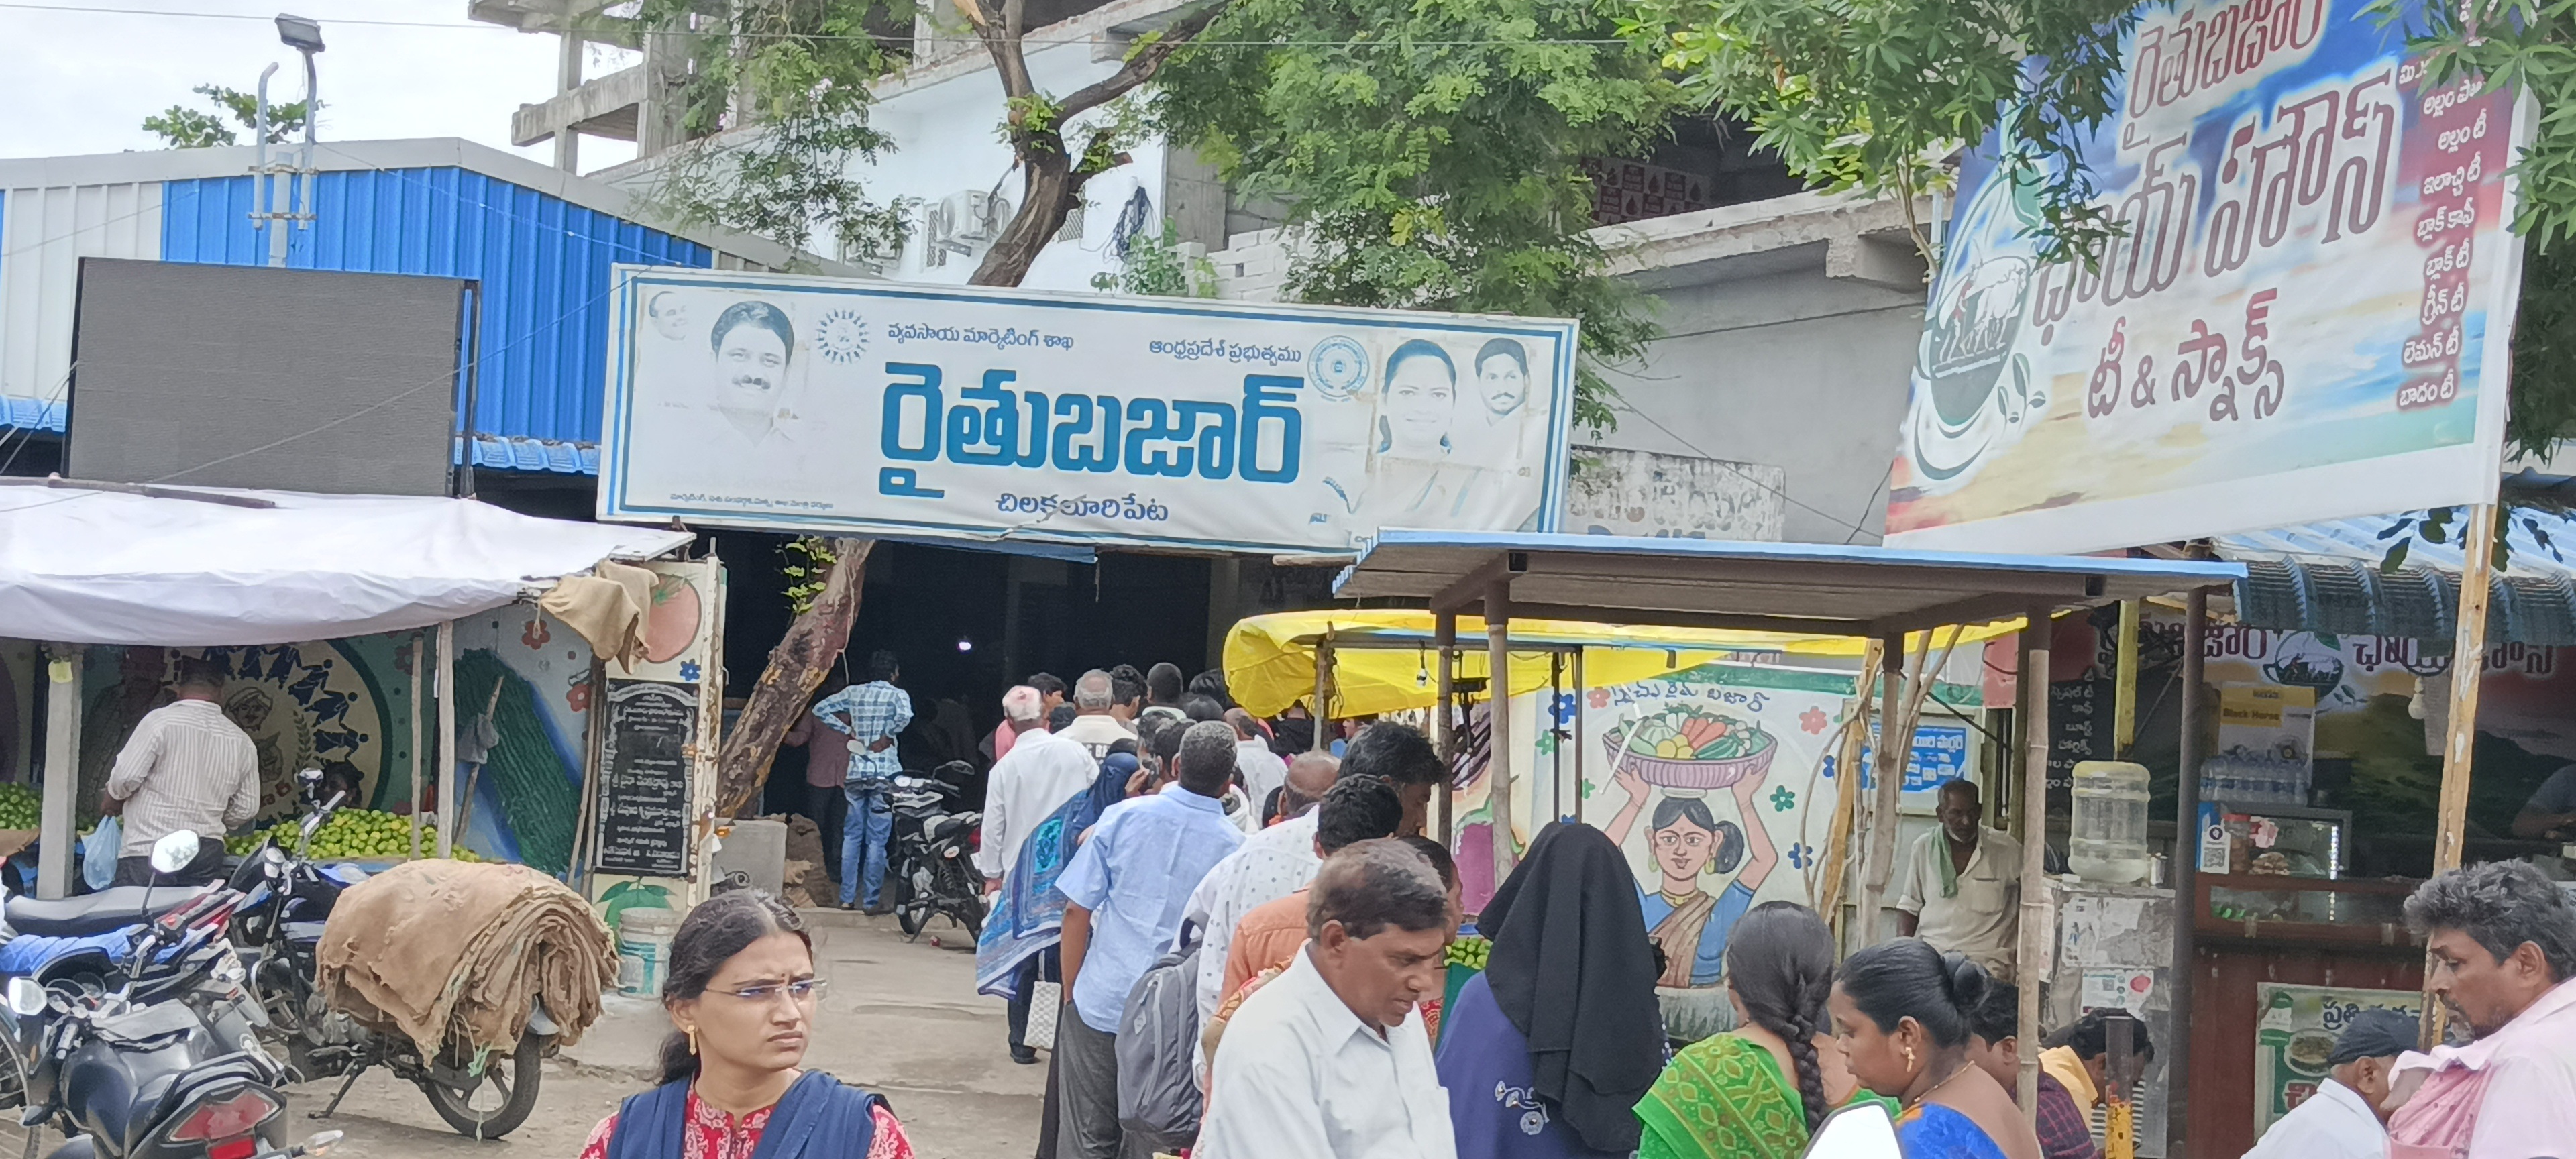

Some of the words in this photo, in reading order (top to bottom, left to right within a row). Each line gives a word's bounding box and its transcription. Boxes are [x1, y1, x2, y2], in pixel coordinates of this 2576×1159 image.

[2122, 0, 2323, 151] రైతుబజార
[2424, 91, 2455, 118] అల్లం
[2438, 126, 2471, 153] అల్లం
[2473, 108, 2487, 139] టీ
[2467, 151, 2481, 182] టీ
[2417, 206, 2447, 242] బ్లాక్
[2426, 245, 2455, 280] బ్లాక్
[2456, 238, 2469, 268] టీ
[2422, 284, 2449, 325] గ్రీన్
[2451, 282, 2464, 312] టీ
[888, 323, 959, 344] వ్యవసాయ
[963, 327, 1040, 351] మార్కెటింగ్
[1043, 335, 1074, 351] శాఖ
[1149, 338, 1226, 360] ఆంధ్రప్రదేశ్
[1229, 343, 1301, 366] ప్రభుత్వము
[2088, 316, 2126, 418] టీ
[2131, 355, 2155, 408] &
[2171, 288, 2284, 421] స్నాక్స్
[2404, 332, 2444, 364] లెమన్
[2445, 325, 2459, 355] టీ
[2399, 382, 2438, 406] బాదం
[2440, 369, 2454, 399] టీ
[879, 362, 1305, 498] రైతుబజార్
